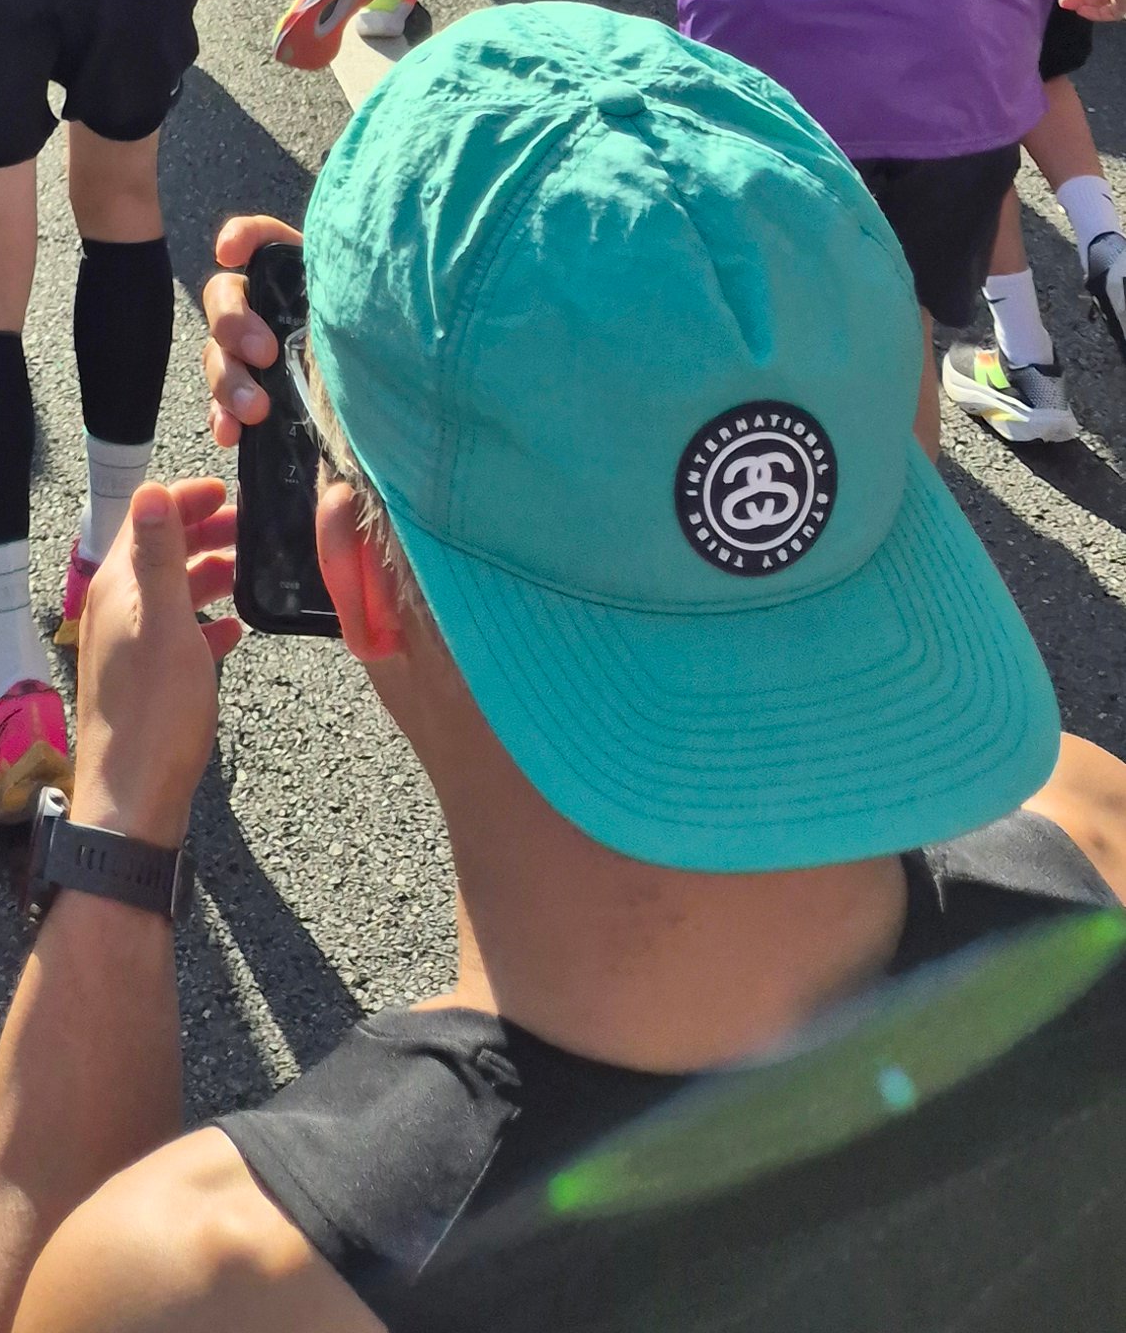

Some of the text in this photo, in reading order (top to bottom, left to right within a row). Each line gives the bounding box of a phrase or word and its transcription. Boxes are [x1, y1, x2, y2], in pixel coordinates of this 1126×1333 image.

[686, 414, 829, 497] INTERNATIONAL
[688, 511, 744, 569] TRIBE
[762, 492, 829, 569] STUSSY
